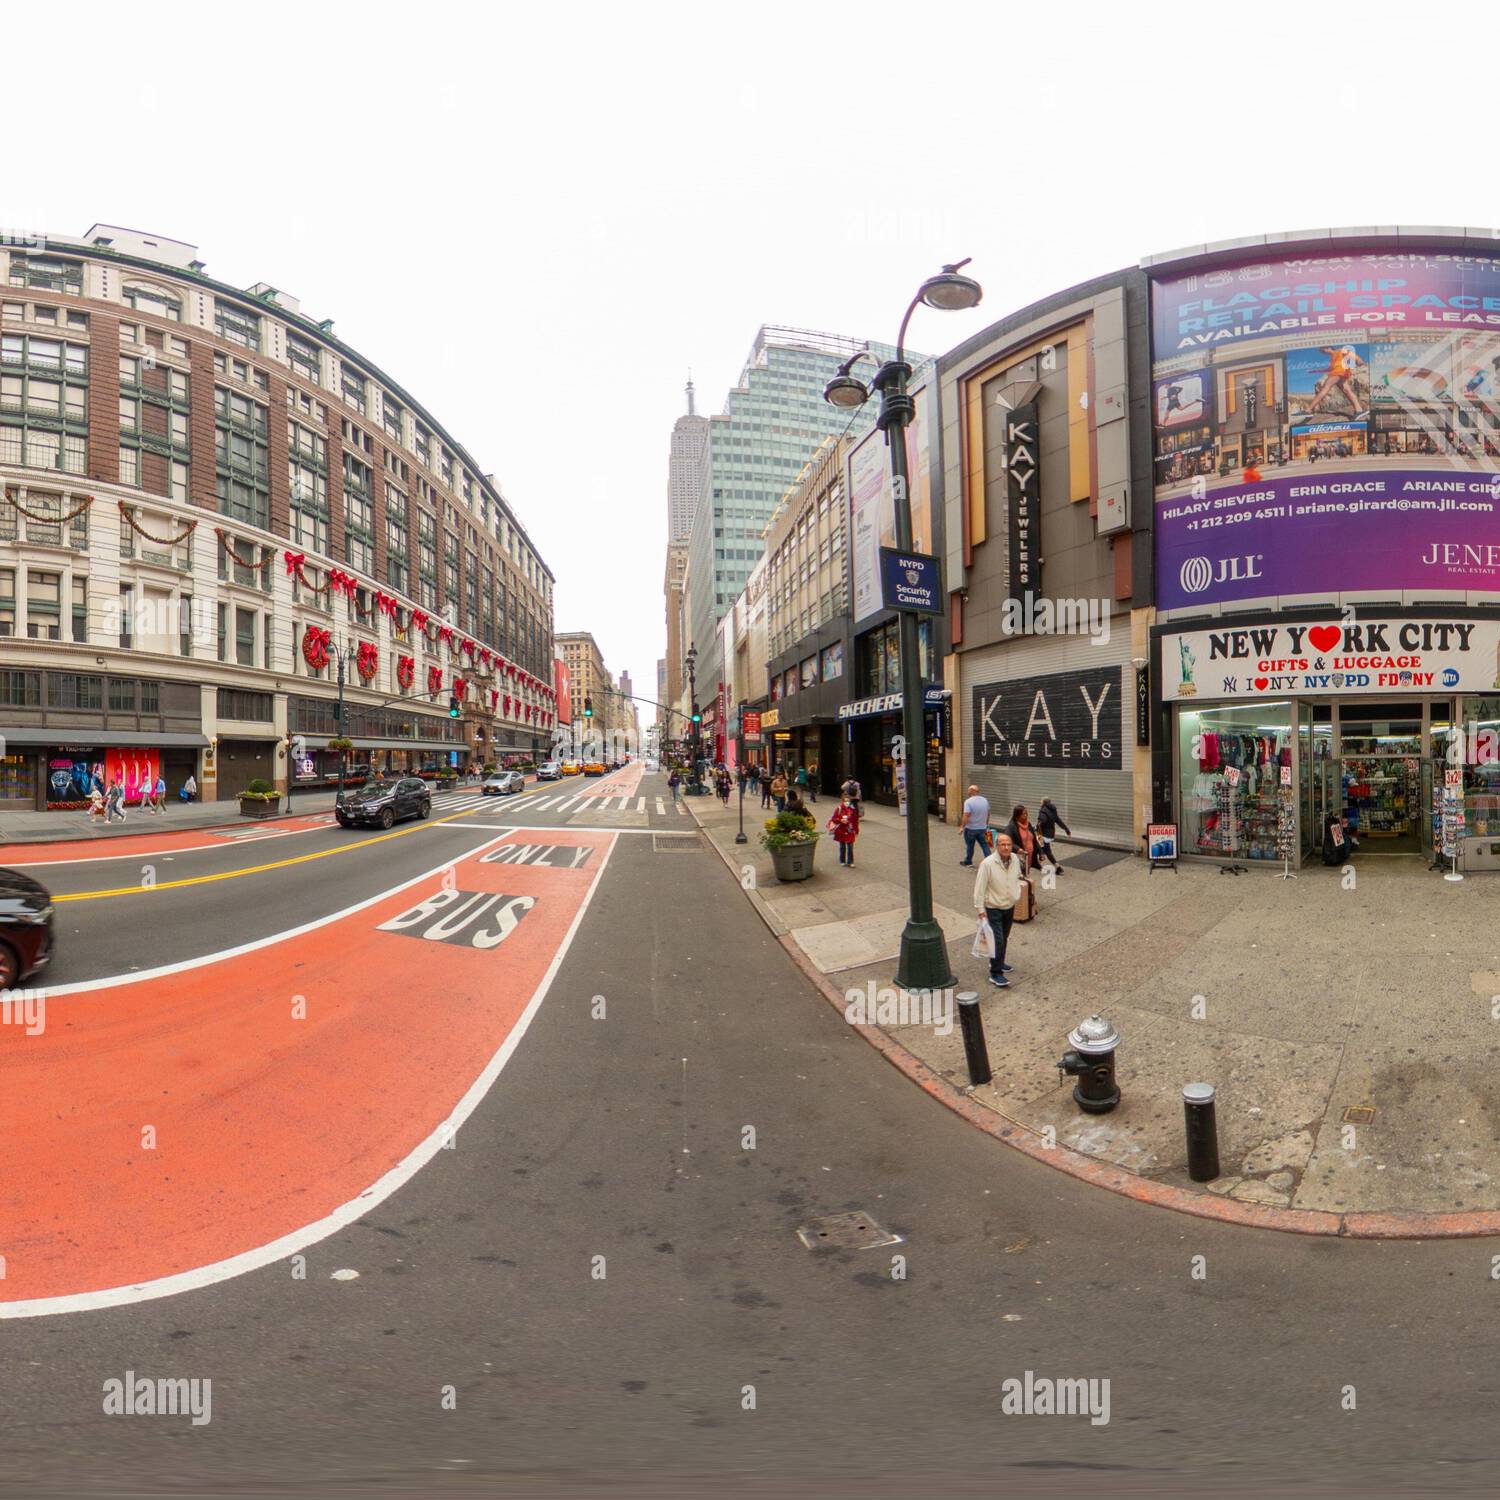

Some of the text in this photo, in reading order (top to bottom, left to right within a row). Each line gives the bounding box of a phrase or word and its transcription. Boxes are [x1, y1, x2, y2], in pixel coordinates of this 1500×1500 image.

[1284, 255, 1353, 268] West
[1362, 254, 1426, 262] 34th
[1285, 264, 1351, 276] New
[1367, 261, 1440, 270] York
[1179, 264, 1272, 292] 138
[1178, 278, 1408, 317] FLAGSHIP
[1178, 297, 1337, 335] RETAIL
[1177, 314, 1336, 350] AVAILABLE
[1343, 311, 1406, 323] FOR
[1289, 481, 1386, 497] ERIN GRACE
[1402, 481, 1466, 493] ARIANE
[1009, 422, 1035, 584] KAY JEWELERS
[1163, 491, 1276, 520] HILARY SIEVERS
[1187, 499, 1493, 531] +1 212 209 4511 ariane.girard@am.jll.com
[899, 559, 925, 570] NYPD
[1469, 567, 1496, 575] ESTATE
[896, 584, 931, 598] Security
[898, 594, 931, 606] Camera
[1209, 628, 1278, 660] NEW
[1399, 623, 1475, 652] CITY
[1258, 656, 1422, 672] GIFTS & LUGGAGE
[839, 693, 903, 718] SKECHERS
[981, 683, 1111, 741] KAY
[981, 742, 1112, 759] JEWELERS
[479, 844, 594, 868] ONLY
[376, 888, 537, 949] BUS
